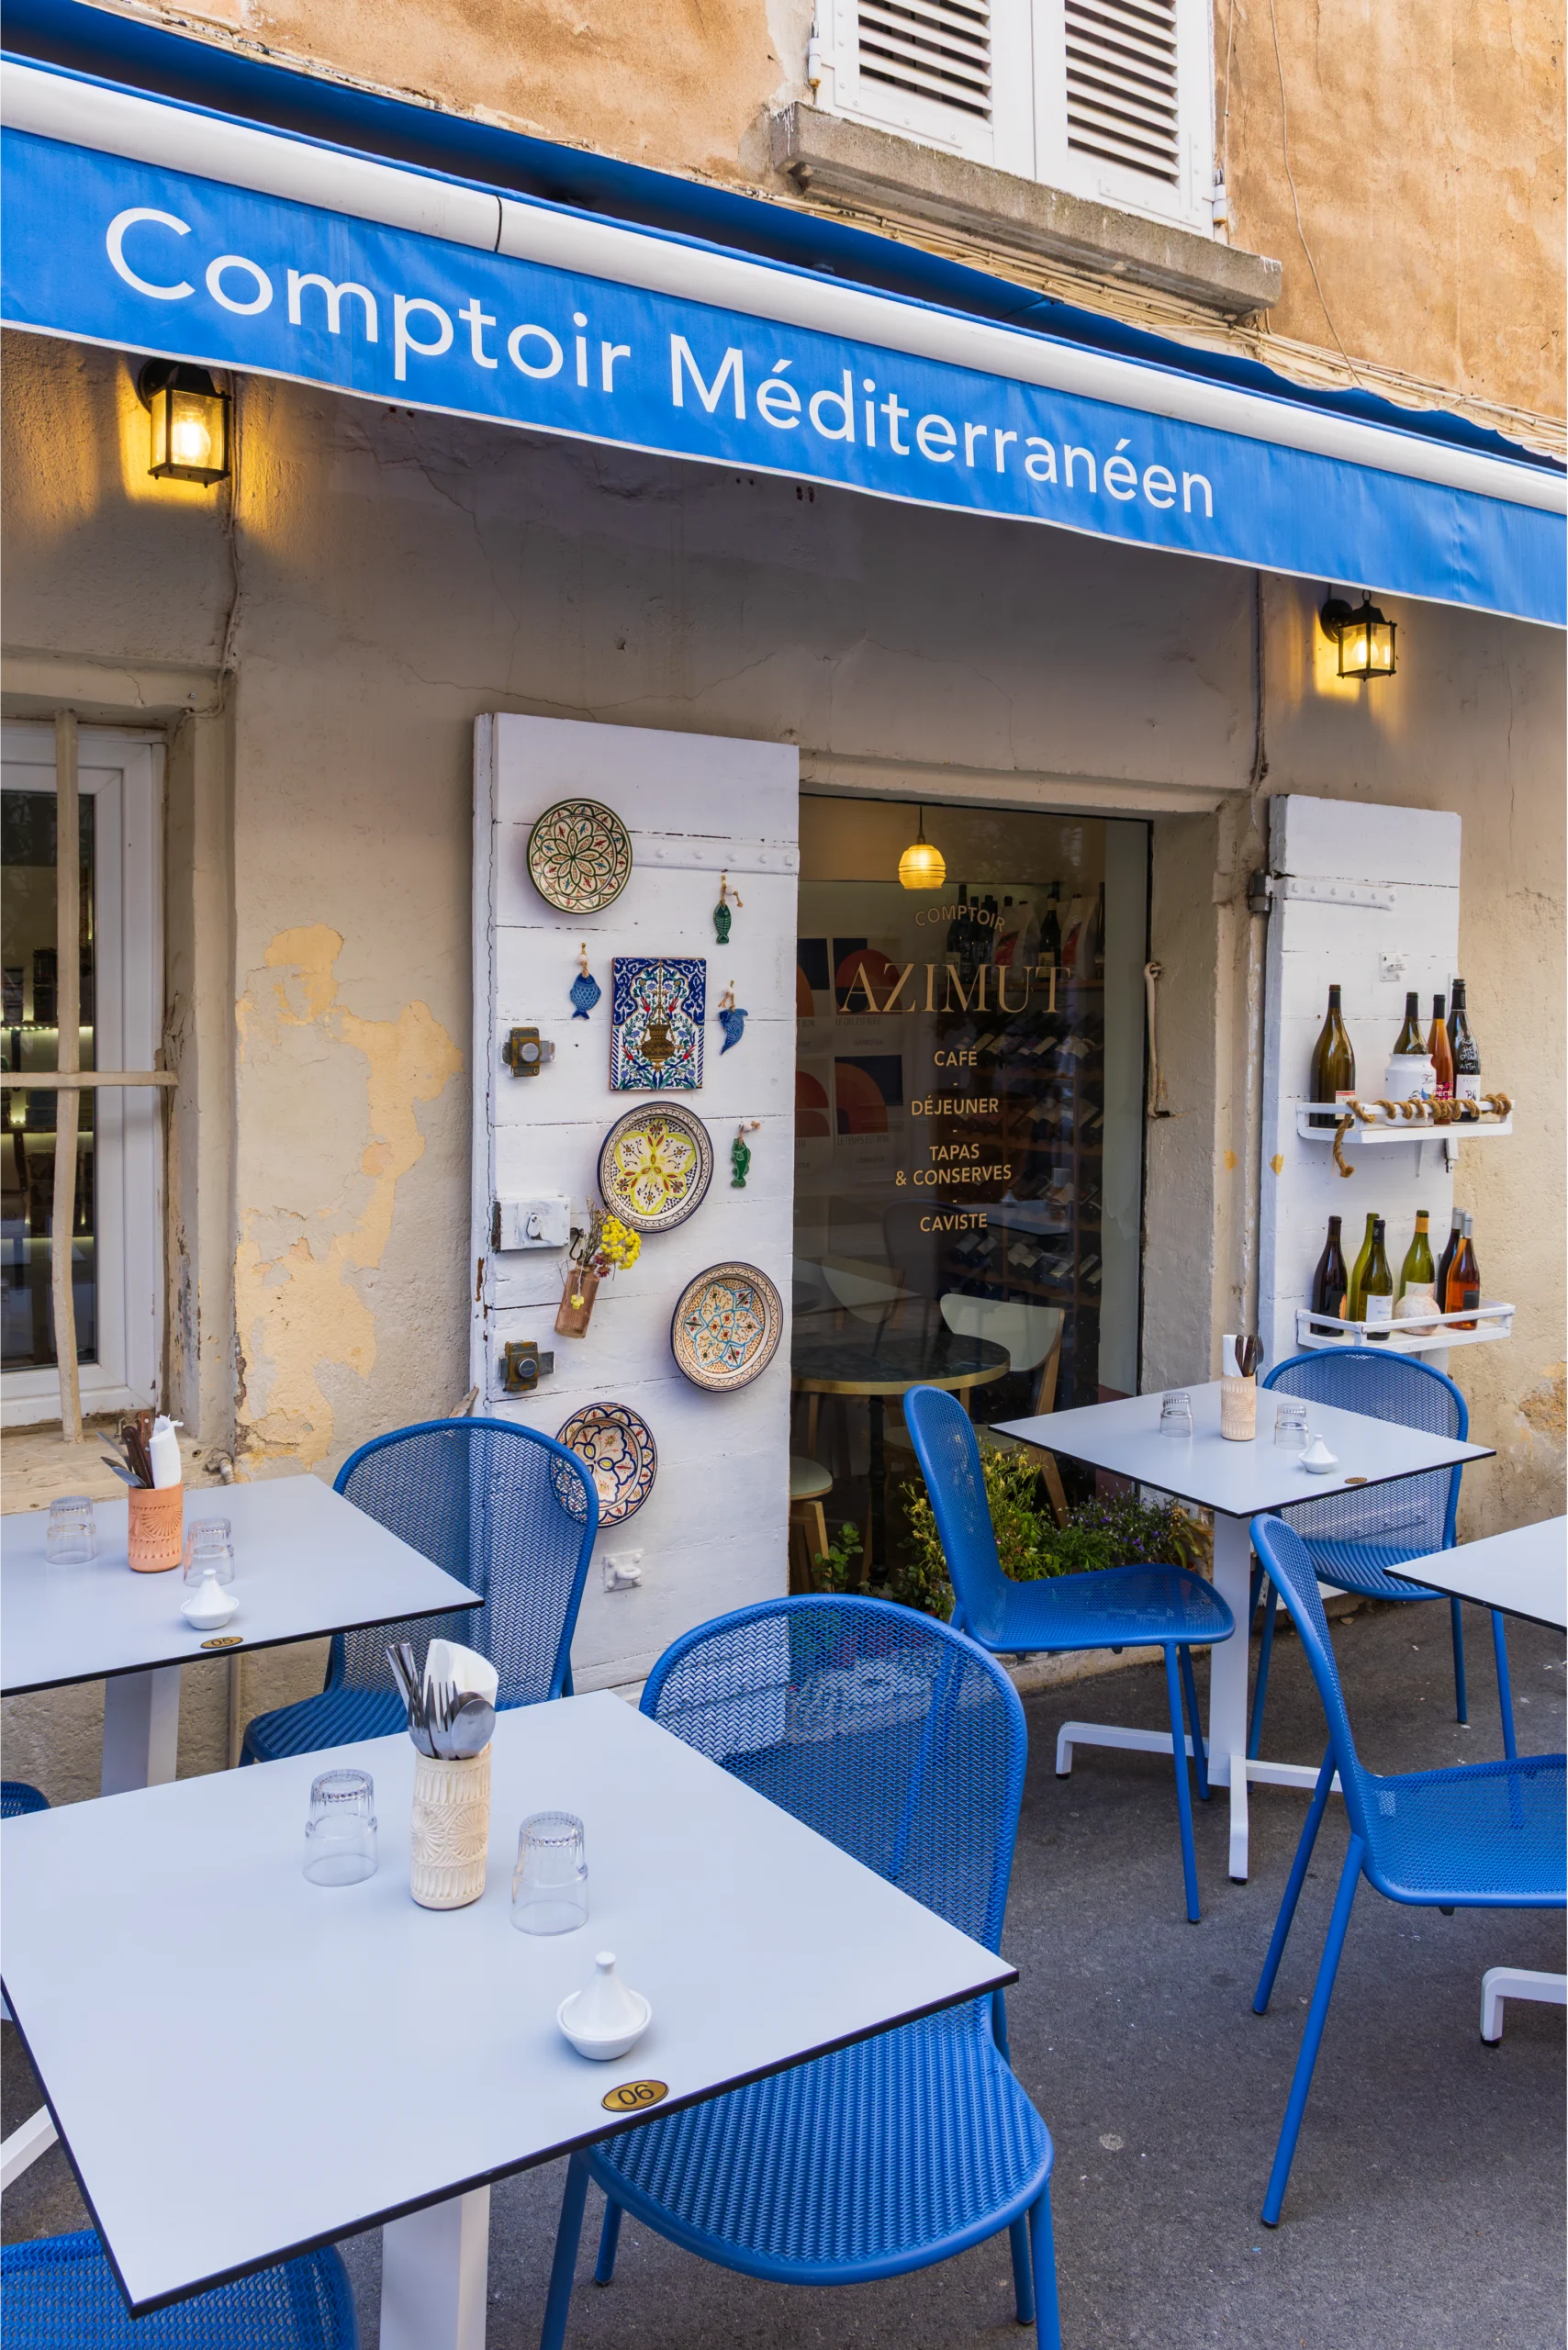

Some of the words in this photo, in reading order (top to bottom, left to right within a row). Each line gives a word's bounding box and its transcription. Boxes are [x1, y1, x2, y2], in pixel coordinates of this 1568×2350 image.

[106, 207, 632, 392] Comptoir
[670, 333, 1214, 518] Méditerranéen
[915, 905, 1005, 933] COMPTOIR
[839, 962, 1071, 1013] AZIMUT
[934, 1046, 978, 1067] CAFÉ
[911, 1095, 999, 1116] DÉJEUNER
[929, 1144, 980, 1161] TAPAS
[895, 1170, 907, 1186] &
[913, 1165, 1012, 1186] CONSERVES
[920, 1213, 988, 1231] CAVISTE
[617, 2084, 655, 2105] 06
